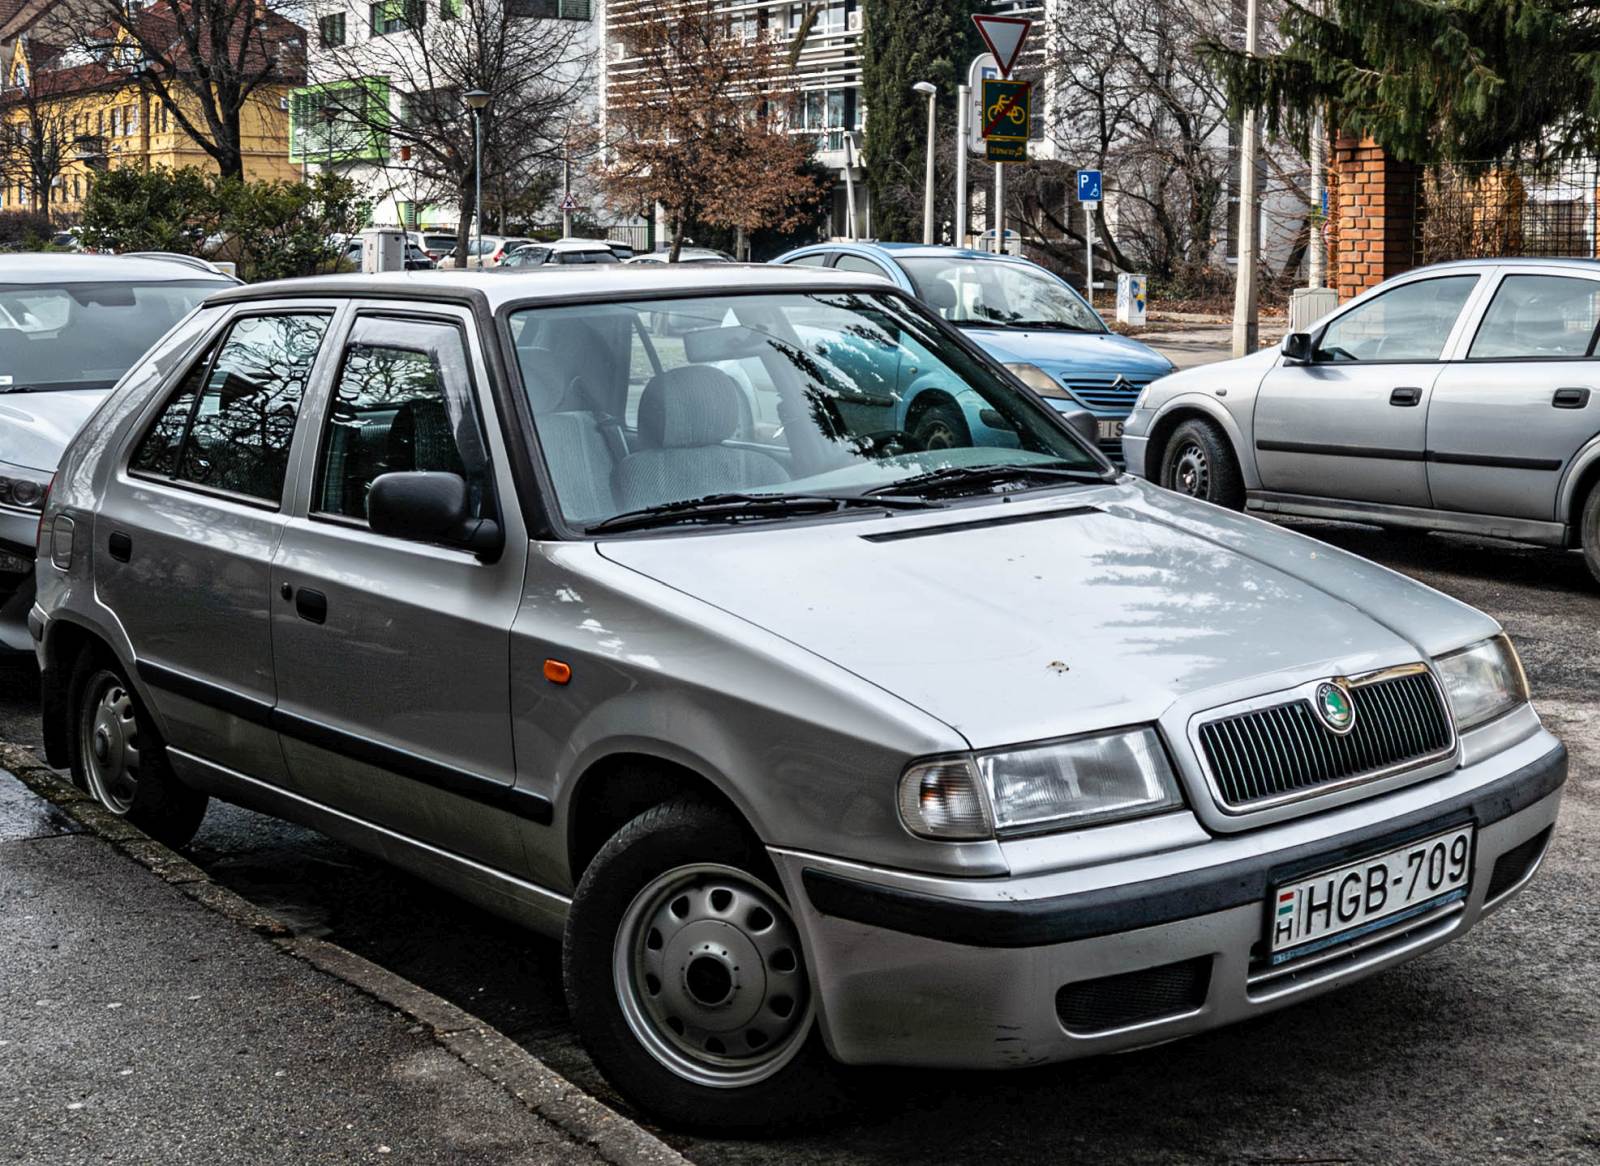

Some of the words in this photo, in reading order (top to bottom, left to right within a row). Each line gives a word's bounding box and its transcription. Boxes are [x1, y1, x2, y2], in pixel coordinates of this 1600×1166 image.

[1081, 174, 1089, 189] P
[1305, 834, 1468, 935] HGB-709
[1275, 918, 1293, 945] H
